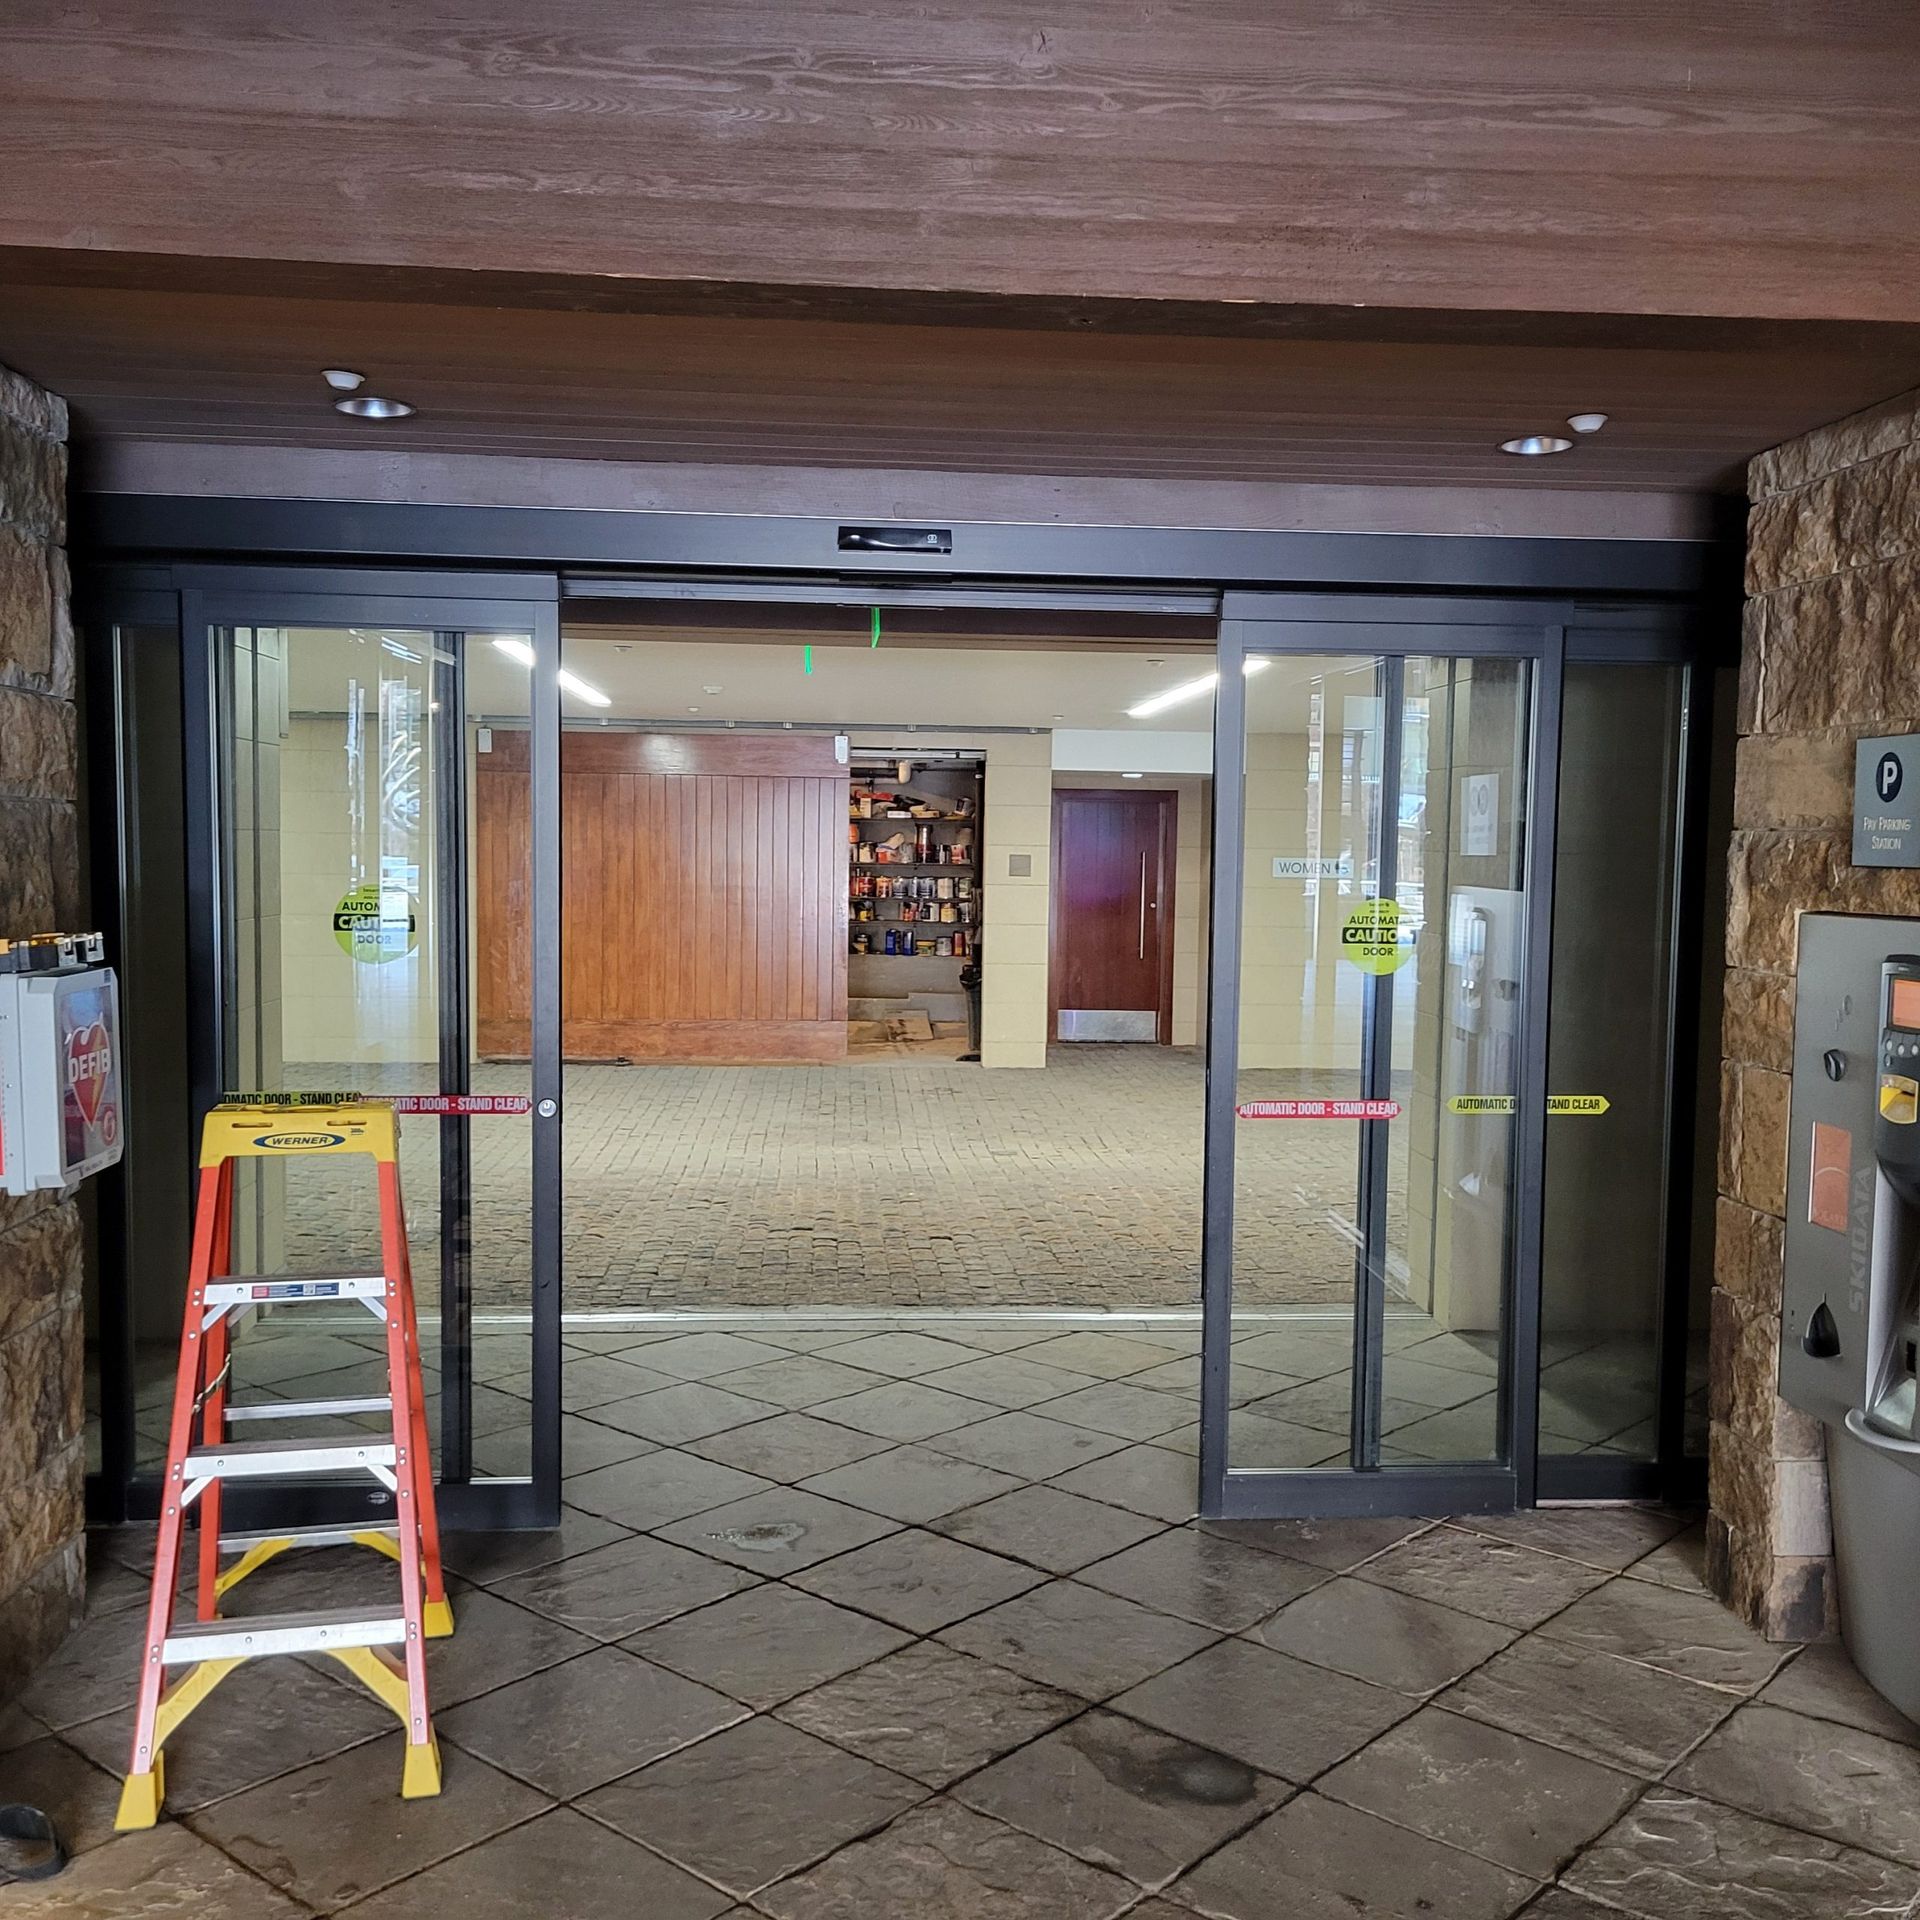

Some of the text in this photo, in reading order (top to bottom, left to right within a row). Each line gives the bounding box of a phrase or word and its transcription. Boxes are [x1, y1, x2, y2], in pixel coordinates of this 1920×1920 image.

[1882, 761, 1898, 794] P
[1279, 862, 1331, 874] WOMEN
[1349, 915, 1399, 925] AUTOMAT
[1345, 928, 1398, 942] CAUTIO
[1363, 947, 1394, 956] DOOR
[69, 1049, 111, 1083] DEFIB
[224, 1093, 262, 1104] OMATIC
[264, 1093, 292, 1104] DOOR
[300, 1093, 332, 1104] STAND
[420, 1097, 449, 1110] DOOR
[457, 1097, 492, 1111] STAND
[494, 1097, 528, 1111] CLEAR
[1456, 1098, 1507, 1110] AUTOMATIC
[1547, 1098, 1600, 1110] TAND CLEAR
[1239, 1102, 1296, 1115] AUTOMATIC
[1298, 1103, 1324, 1115] DOOR
[1333, 1102, 1364, 1115] STAND
[1366, 1103, 1398, 1115] CLEAR
[272, 1136, 328, 1146] WERNER
[1849, 1166, 1871, 1314] SKIDATA
